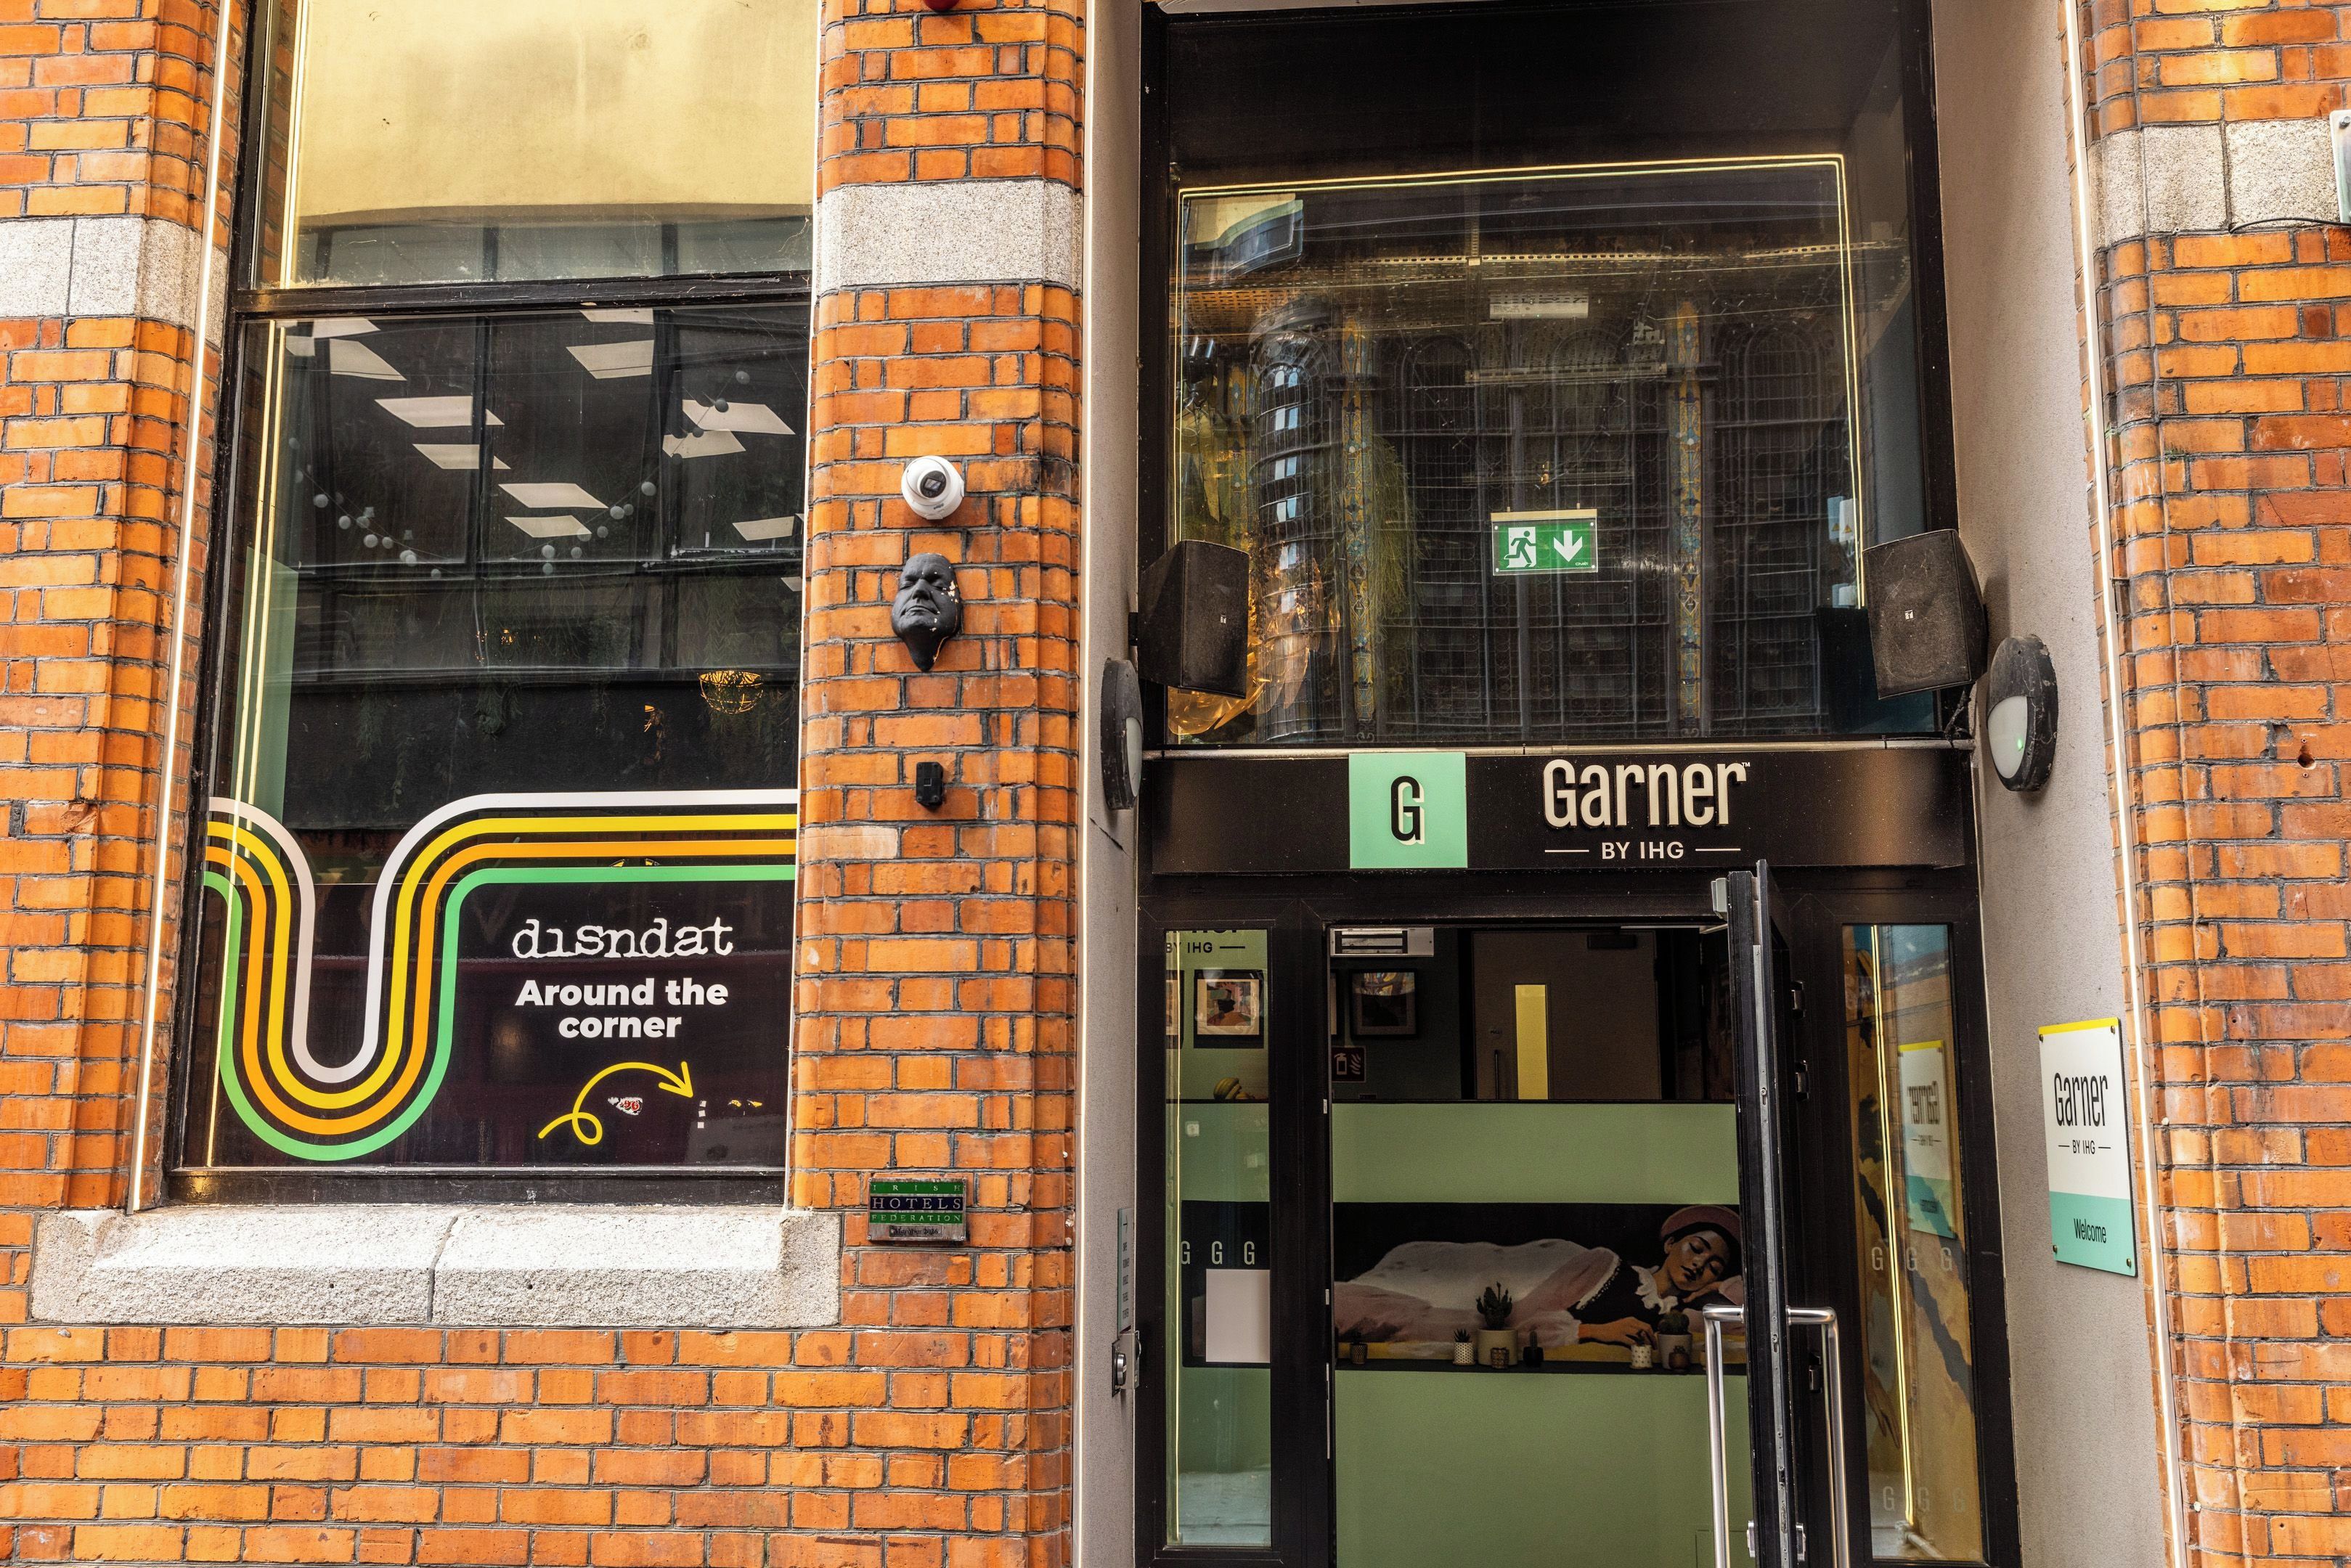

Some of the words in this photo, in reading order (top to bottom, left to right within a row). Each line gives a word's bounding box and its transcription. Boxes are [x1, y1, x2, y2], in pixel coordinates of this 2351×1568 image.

[1390, 775, 1425, 845] G
[1601, 841, 1631, 860] BY
[1639, 841, 1684, 859] IHG
[511, 915, 733, 959] disndat
[1187, 942, 1213, 953] IHG
[514, 977, 655, 1006] Around
[664, 977, 729, 1005] the
[558, 1016, 682, 1038] corner
[2054, 1072, 2108, 1127] Garner
[2072, 1139, 2080, 1153] BY
[2082, 1139, 2095, 1154] IHG
[872, 1198, 961, 1209] HOTELS
[2073, 1217, 2107, 1244] Welcome
[1211, 1241, 1223, 1265] G
[1244, 1241, 1255, 1265] G
[1871, 1246, 1883, 1270] G
